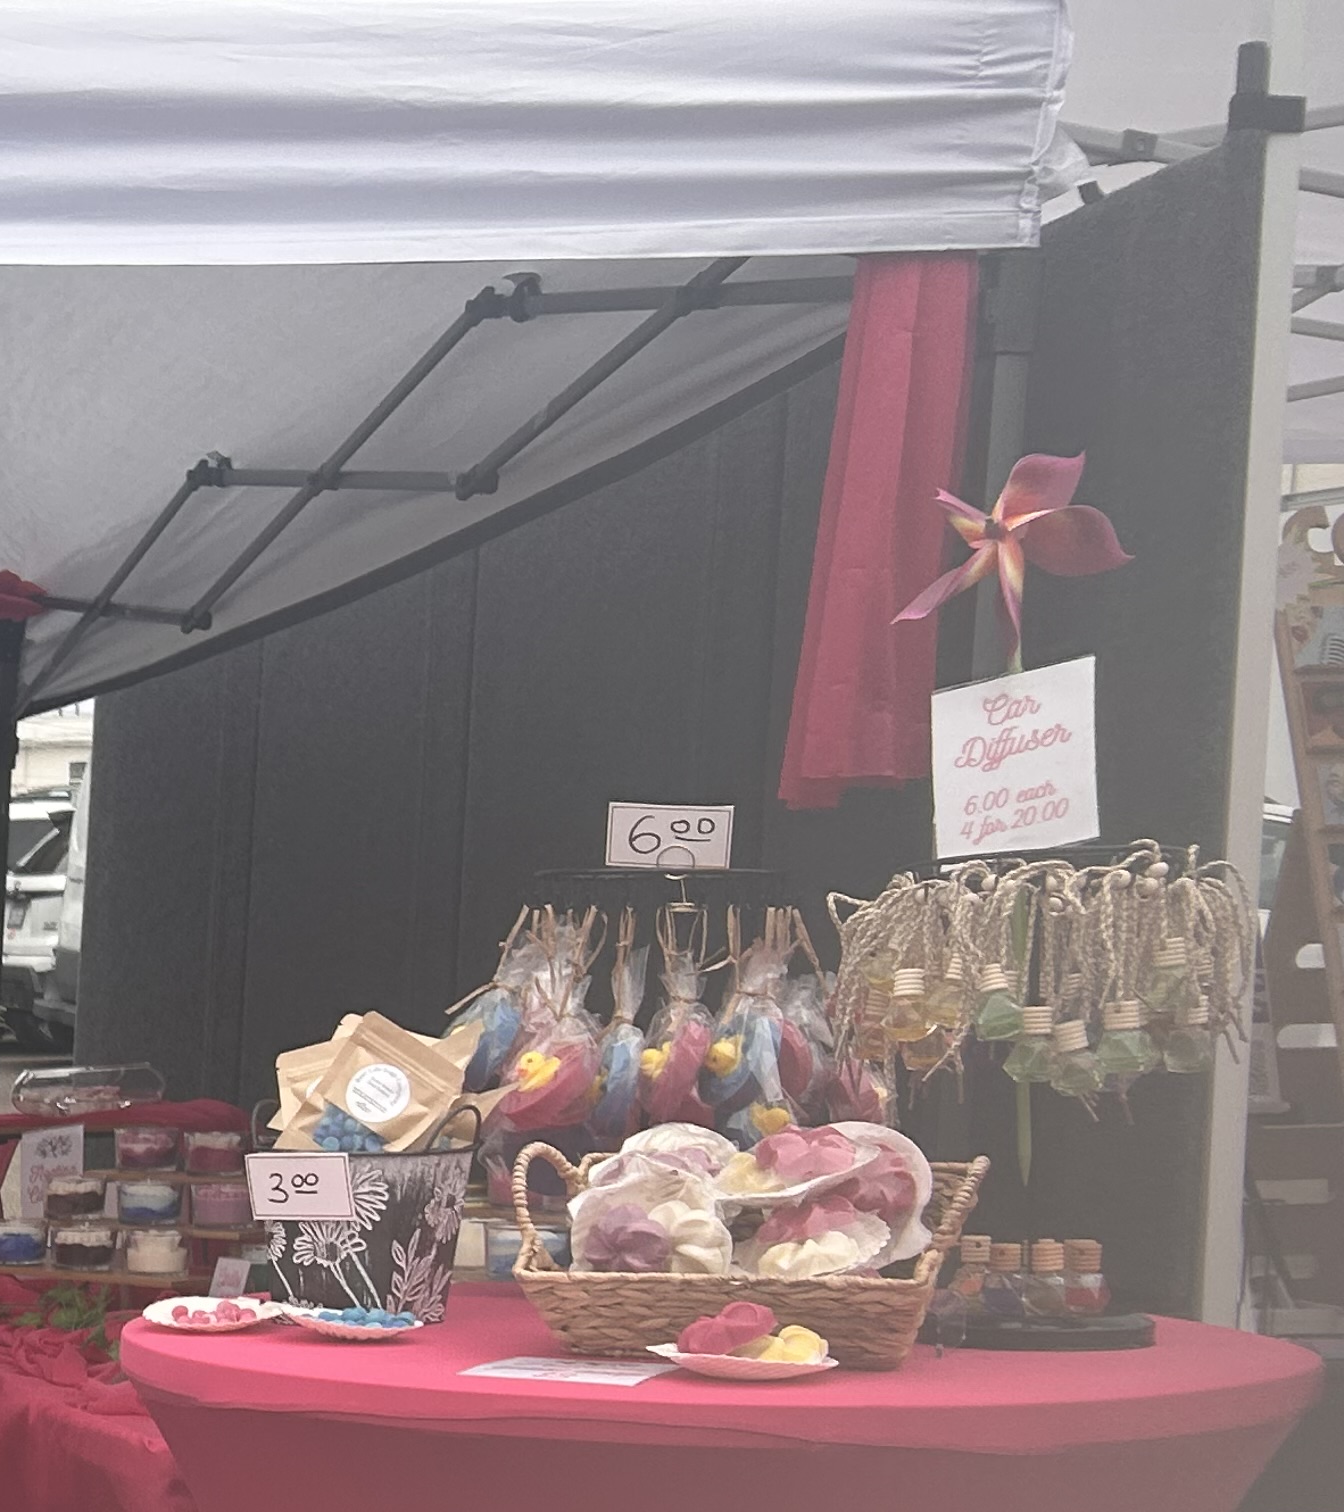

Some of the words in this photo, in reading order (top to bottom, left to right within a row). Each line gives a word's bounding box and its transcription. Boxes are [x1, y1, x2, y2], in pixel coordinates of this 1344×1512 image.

[982, 693, 1042, 726] Car
[954, 723, 1072, 772] Diffuser
[964, 787, 1010, 816] 6.00
[1016, 780, 1057, 803] each
[960, 820, 975, 840] 4
[972, 815, 1008, 846] for
[1010, 797, 1070, 829] 20.00
